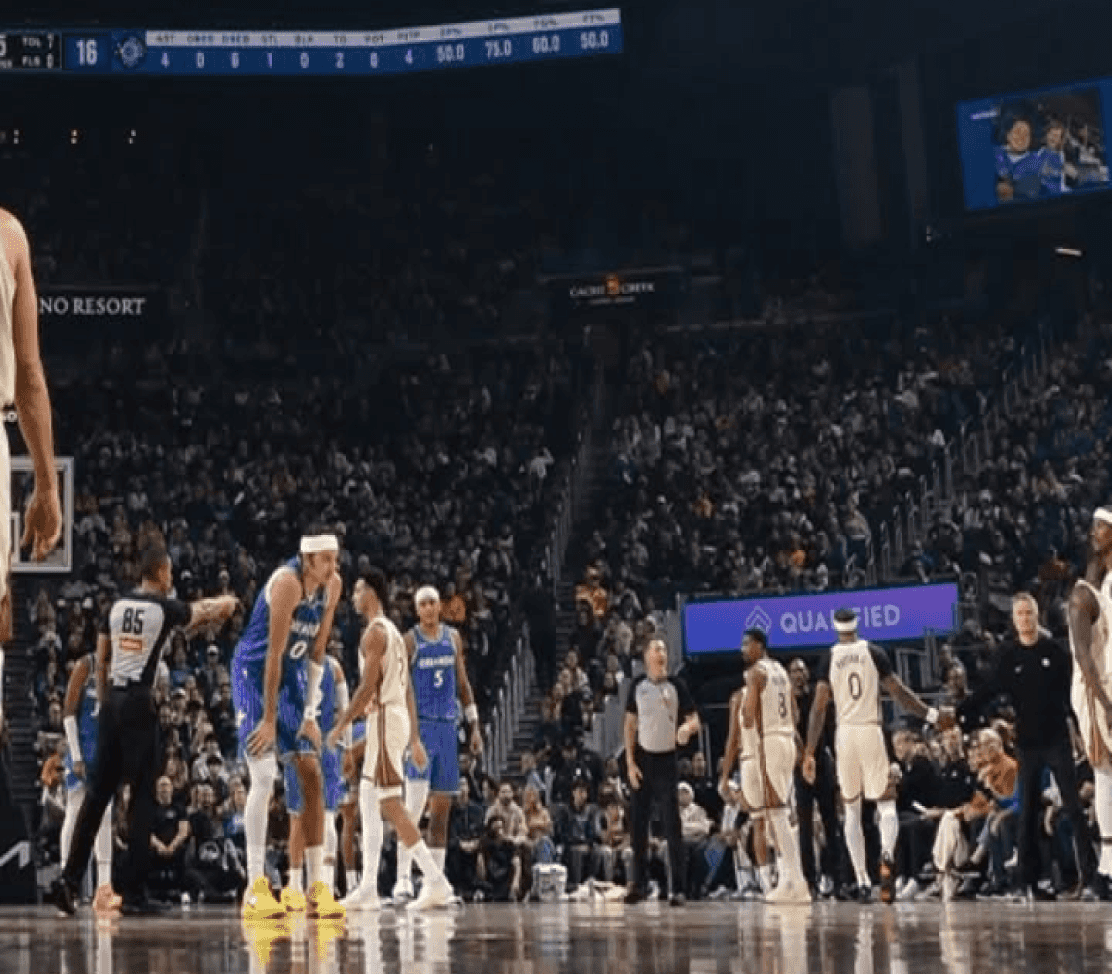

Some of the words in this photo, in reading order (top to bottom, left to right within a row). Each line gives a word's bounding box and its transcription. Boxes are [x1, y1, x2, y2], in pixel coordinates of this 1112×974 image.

[76, 39, 98, 66] 16
[161, 52, 170, 68] 4
[267, 52, 273, 68] 1
[336, 52, 345, 68] 2
[404, 48, 413, 65] 4
[73, 297, 146, 316] RESORT
[122, 608, 146, 635] 85
[289, 639, 308, 660] 0
[848, 671, 862, 701] 0
